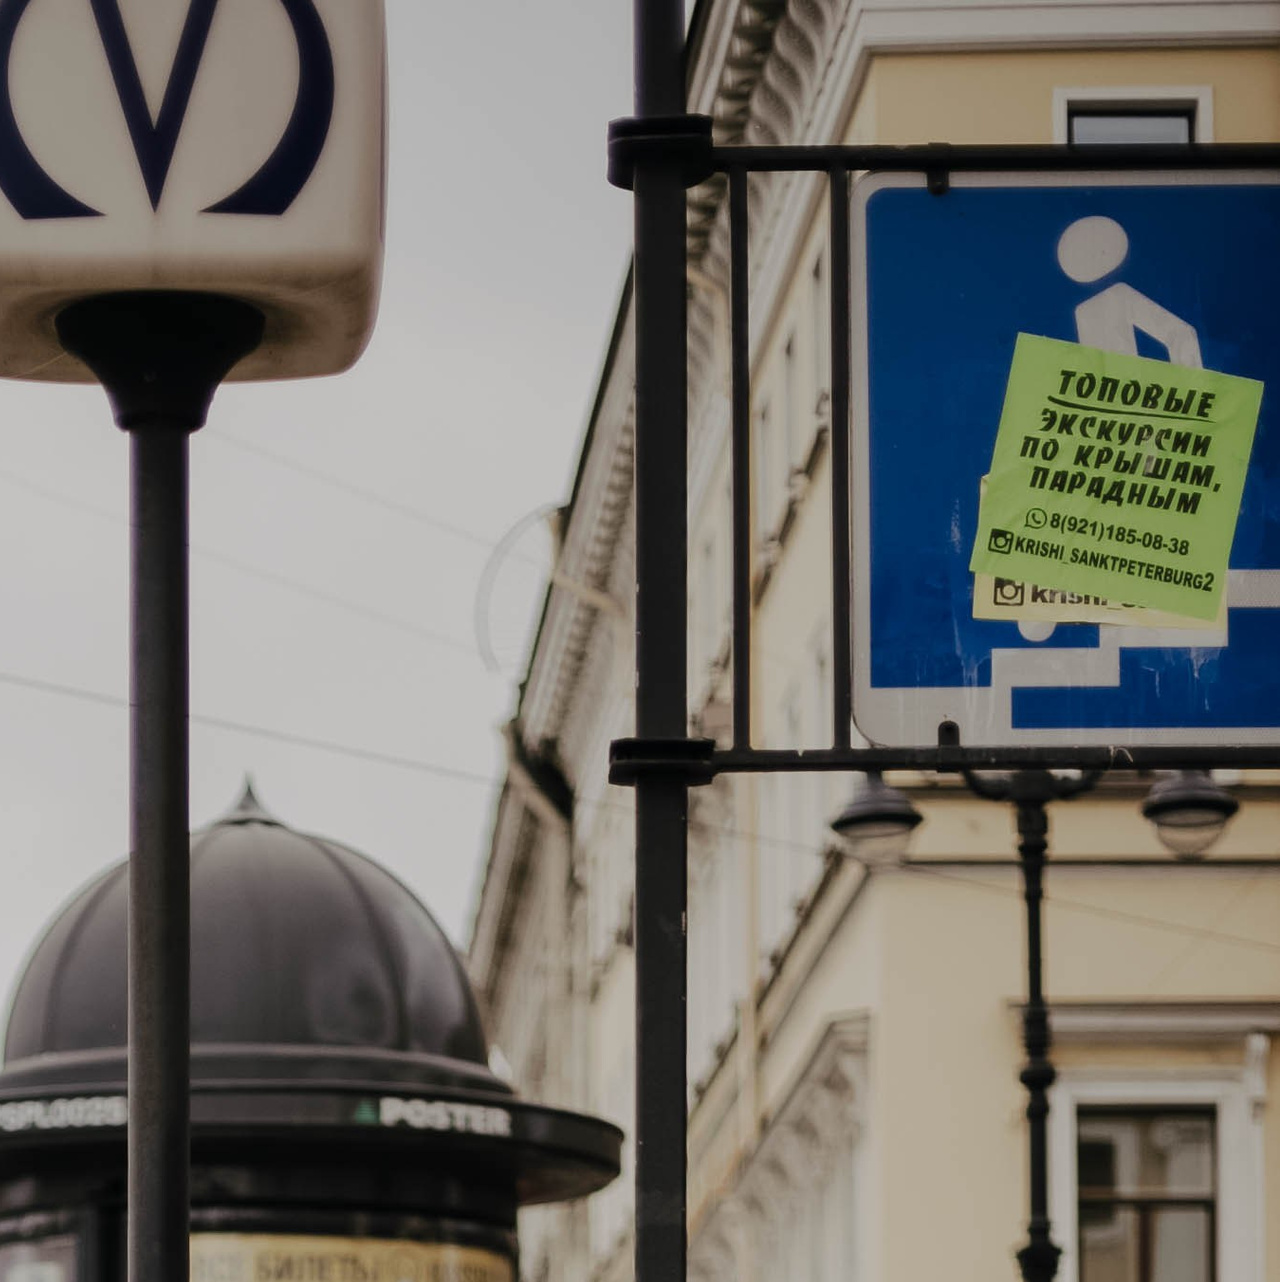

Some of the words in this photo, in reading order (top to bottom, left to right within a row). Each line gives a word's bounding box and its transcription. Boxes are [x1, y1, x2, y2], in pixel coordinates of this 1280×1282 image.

[1058, 369, 1217, 418] ТОПОВЫЕ
[1038, 407, 1213, 458] ЭКСКУРСИИ
[1019, 435, 1060, 461] ПО
[1073, 444, 1222, 493] КРЫШАМ,
[1029, 465, 1203, 515] ПАРАДНЫМ
[1049, 512, 1191, 556] 8(921)185-08-38
[1014, 535, 1215, 593] KRISHI_SANKTPETERBURG2
